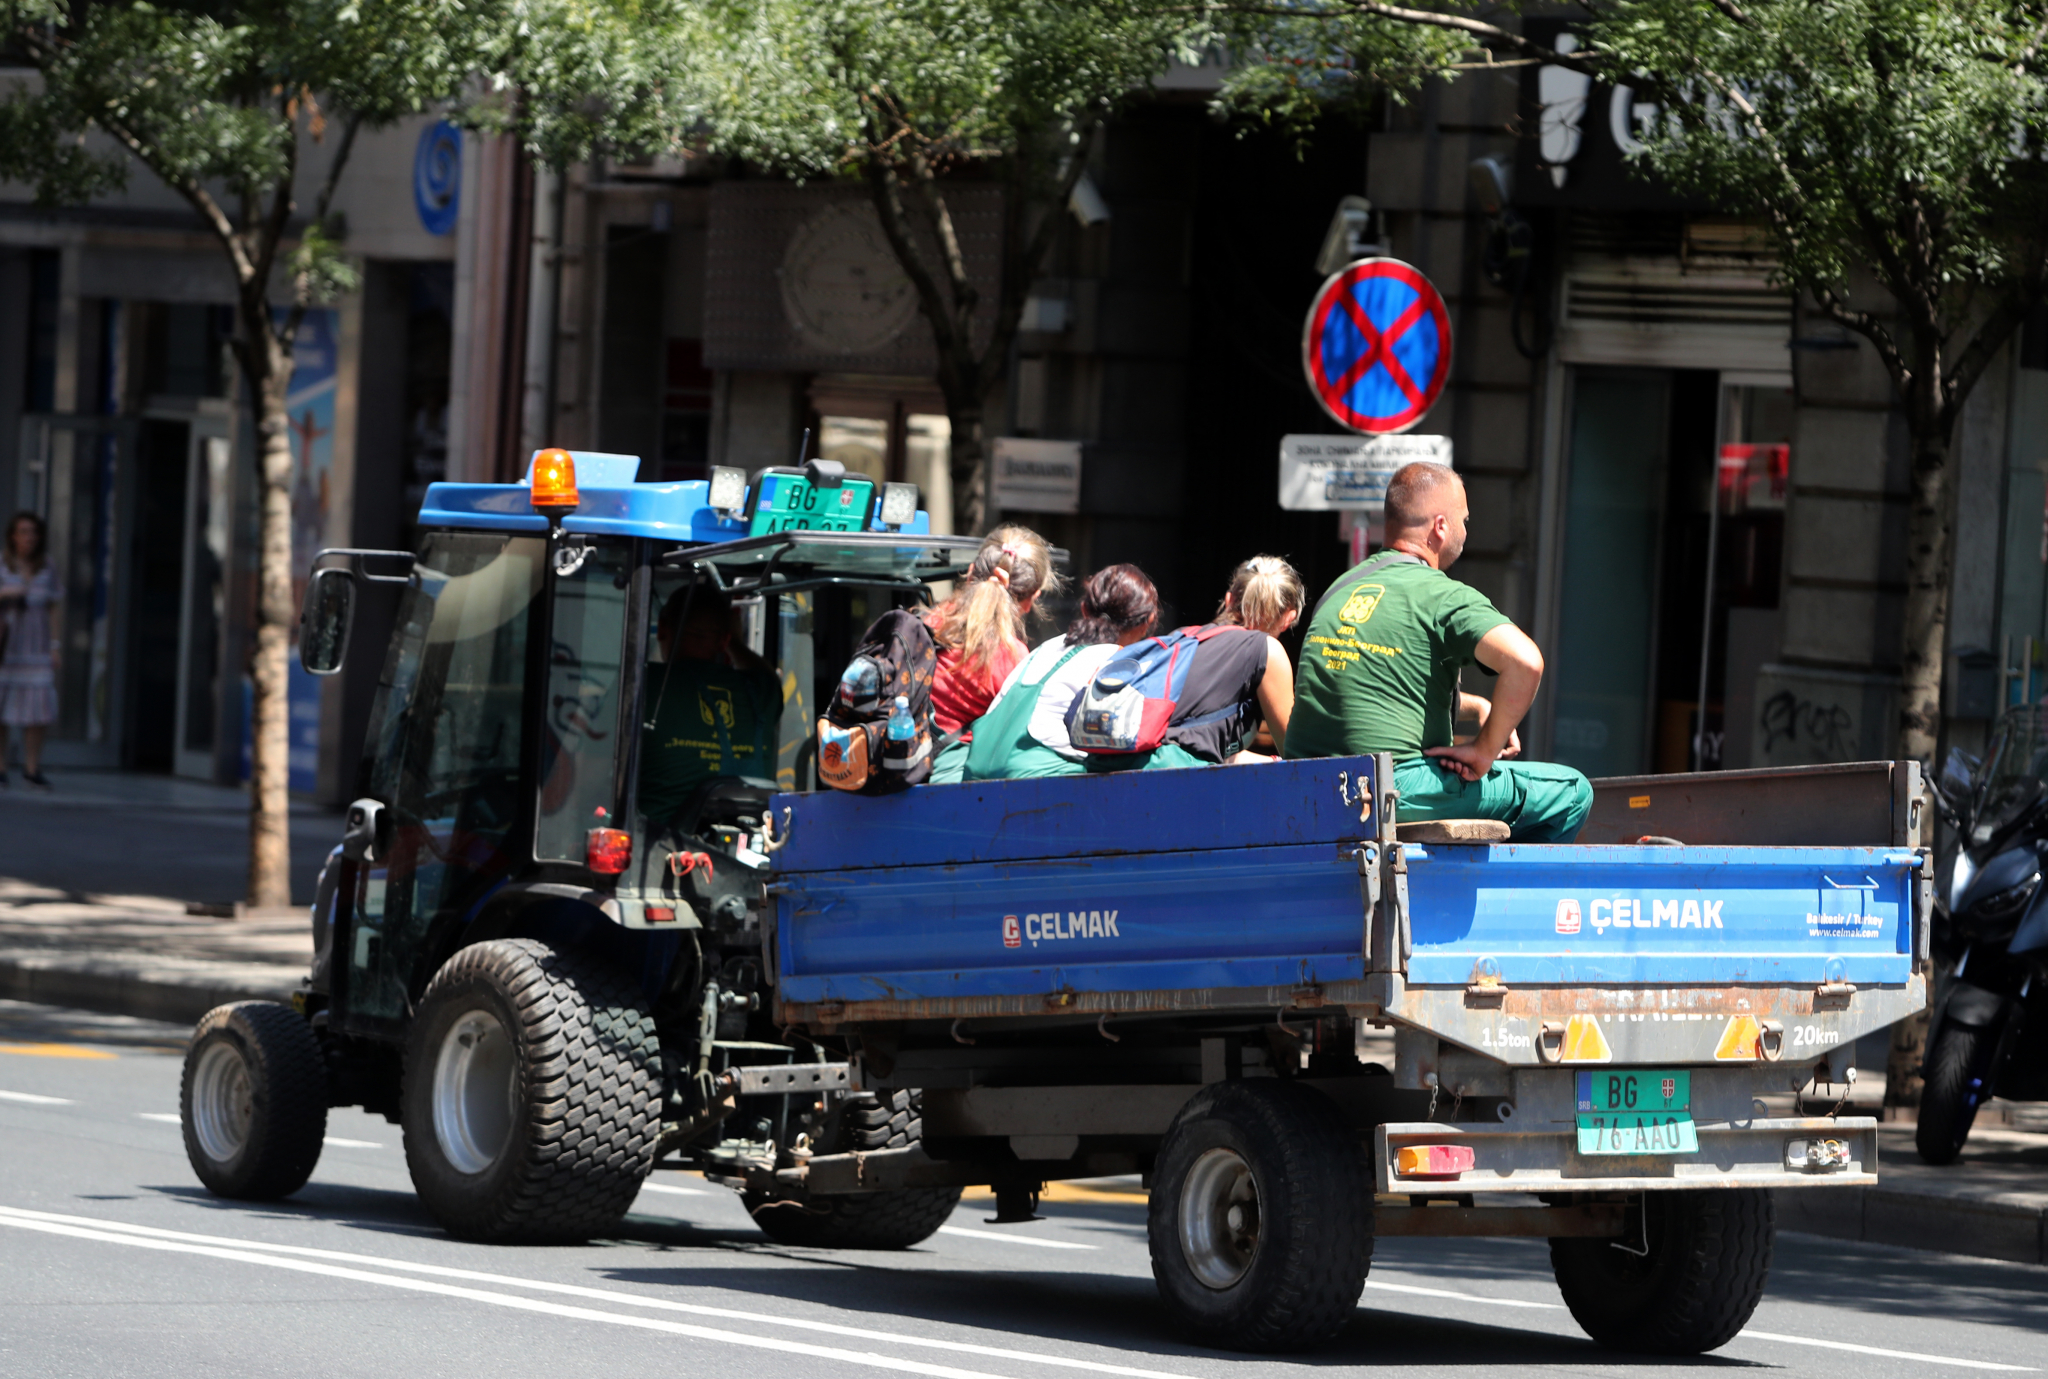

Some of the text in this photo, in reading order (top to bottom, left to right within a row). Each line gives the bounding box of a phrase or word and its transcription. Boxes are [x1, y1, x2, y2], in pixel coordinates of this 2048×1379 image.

[788, 483, 818, 510] BG
[1322, 647, 1361, 661] Београд
[1325, 660, 1347, 671] 2021
[1590, 898, 1724, 935] ÇELMAK
[1025, 909, 1120, 948] ÇELMAK
[1809, 927, 1880, 939] www.celmak.com
[1482, 1027, 1531, 1048] 1.5ton
[1793, 1025, 1839, 1046] 20km
[1608, 1075, 1638, 1109] BG
[1578, 1101, 1591, 1110] SRB
